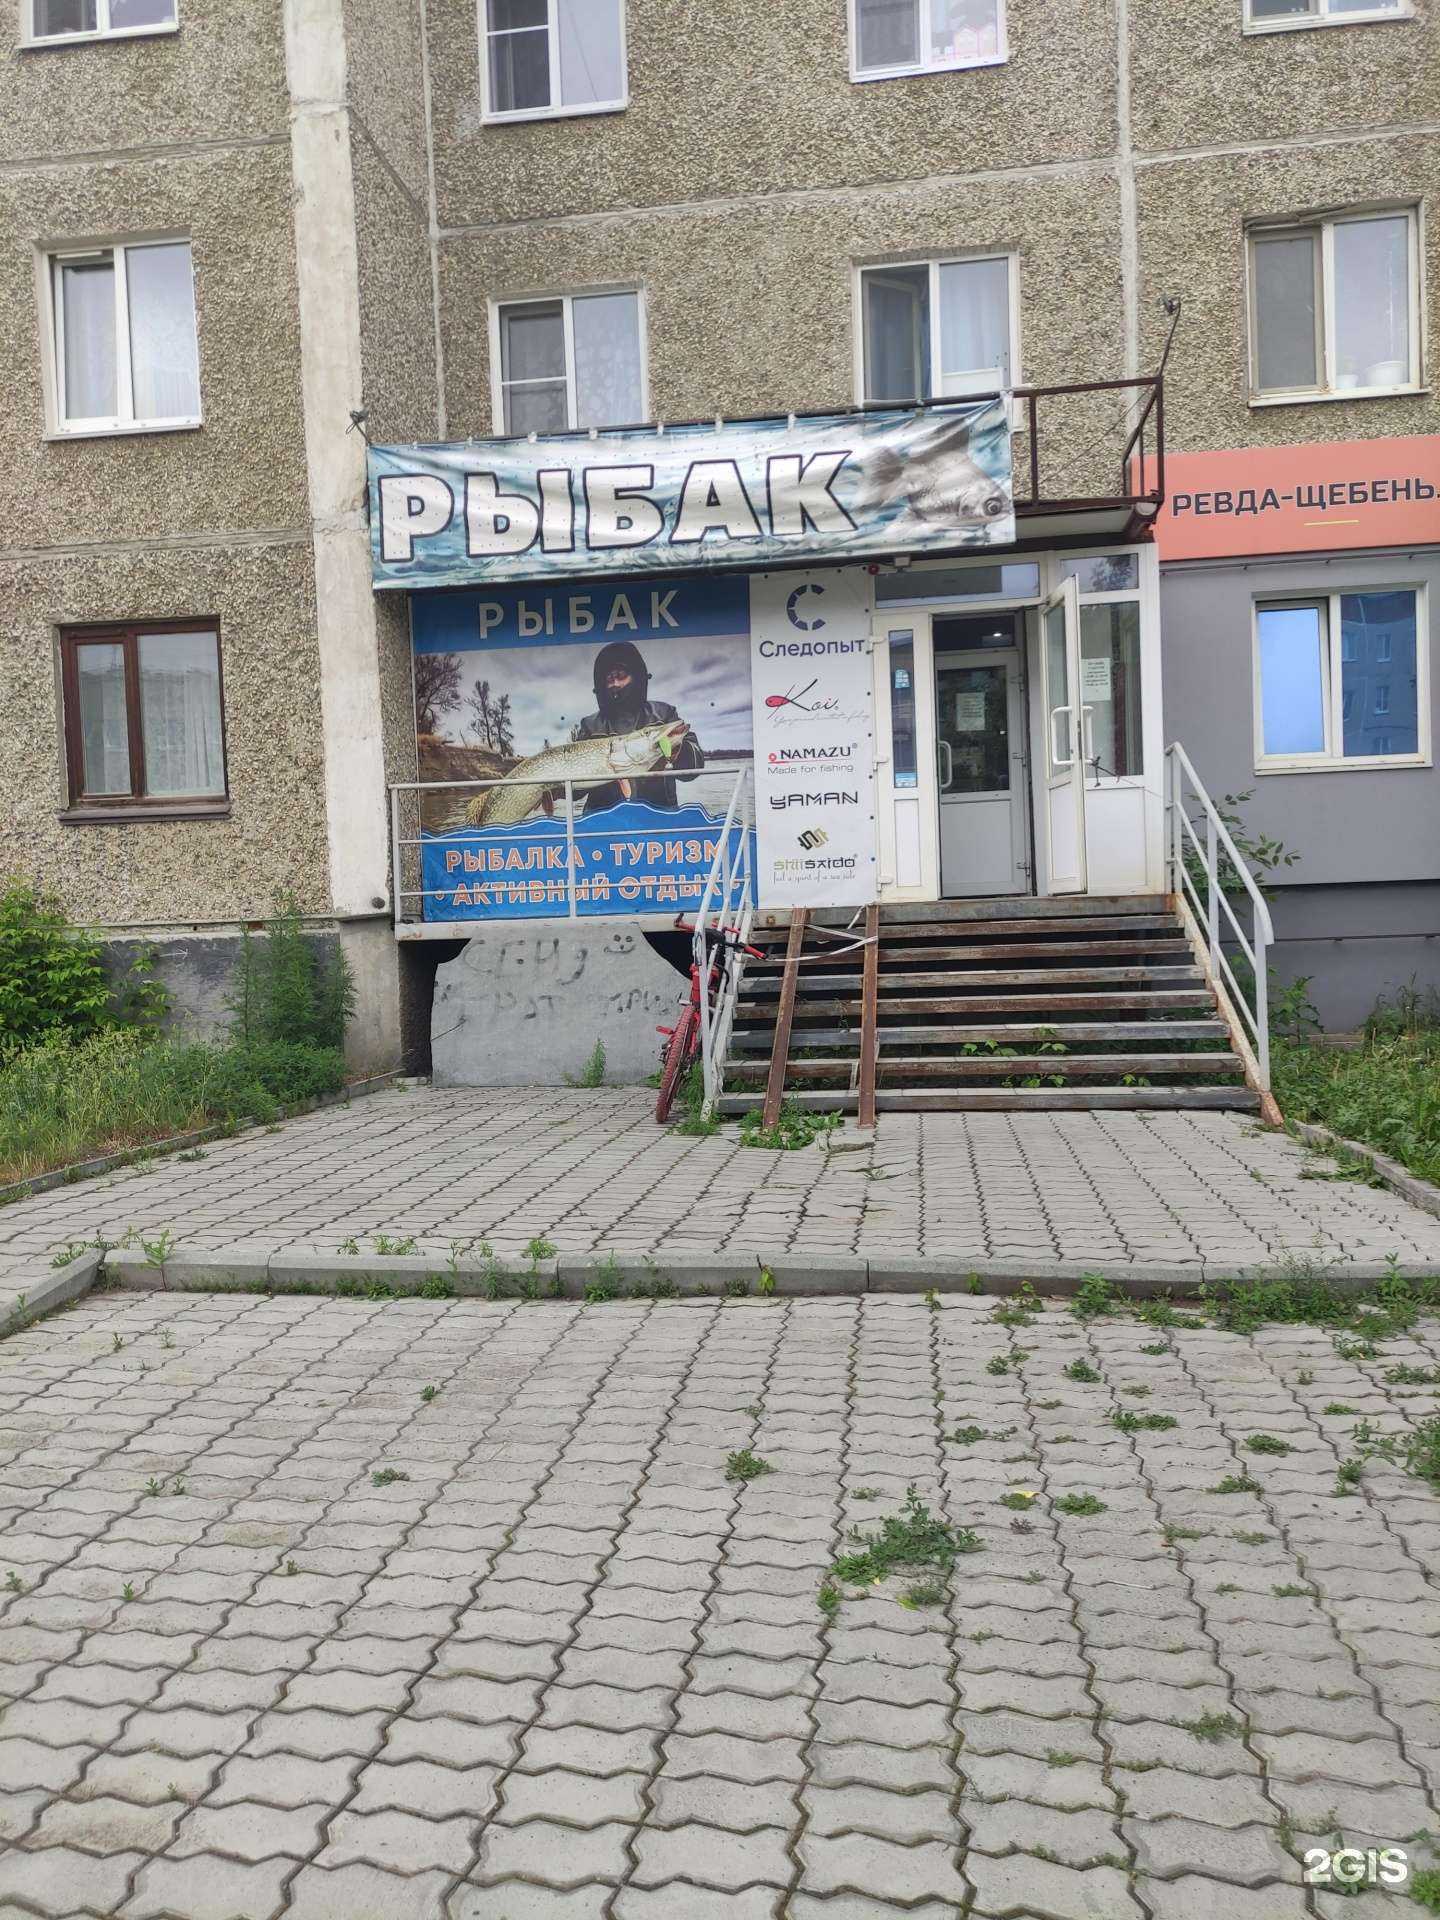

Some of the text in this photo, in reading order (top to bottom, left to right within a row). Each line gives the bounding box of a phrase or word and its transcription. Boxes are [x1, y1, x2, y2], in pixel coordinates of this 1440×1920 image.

[378, 450, 859, 564] РЫБАК
[478, 590, 681, 640] РЫБАК
[759, 639, 866, 658] Следопыт
[780, 746, 851, 760] NAMAZU
[768, 763, 854, 775] Made for fishing
[770, 791, 858, 810] YAMAN
[445, 845, 585, 872] РЫБАЛКА
[453, 872, 610, 906] АКТИВНЫЙ
